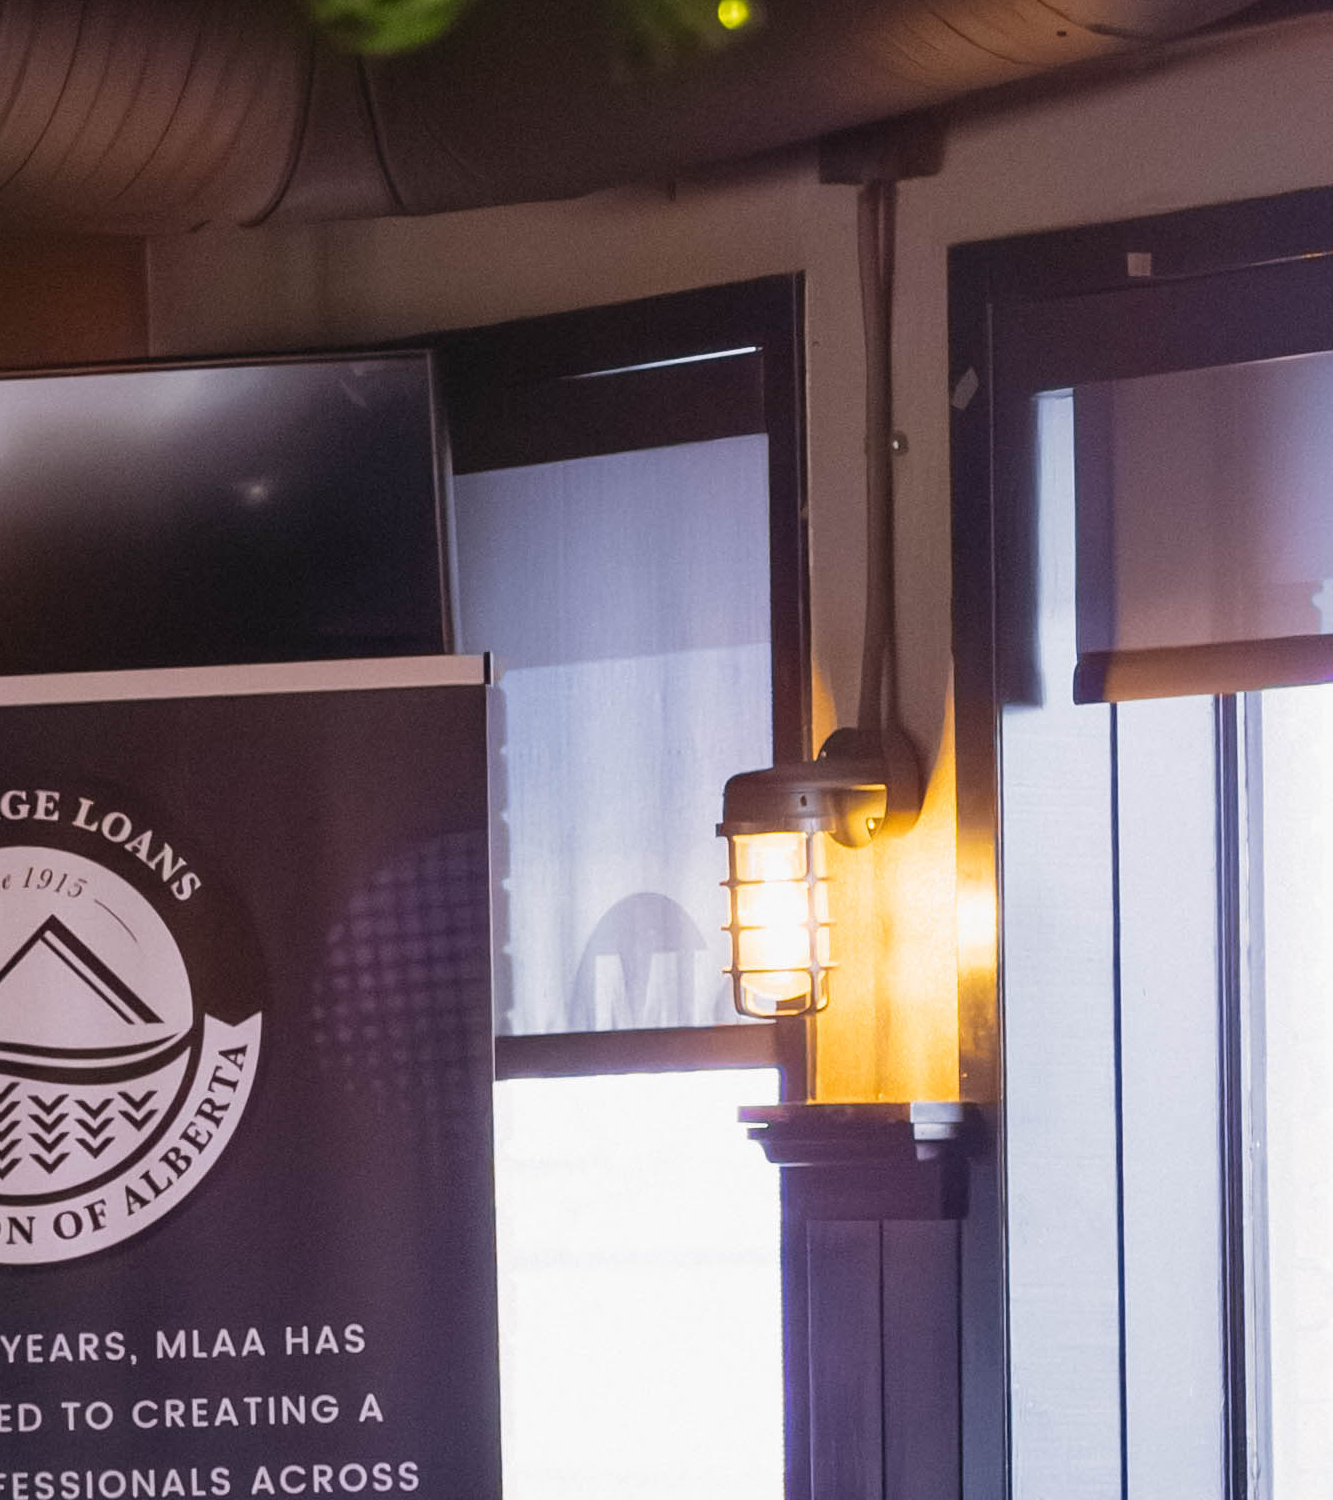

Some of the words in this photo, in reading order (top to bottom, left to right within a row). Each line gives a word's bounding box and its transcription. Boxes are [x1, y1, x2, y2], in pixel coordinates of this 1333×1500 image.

[72, 797, 202, 902] LOANS
[21, 866, 88, 900] 1915
[53, 1199, 110, 1241] OF
[125, 1043, 249, 1216] ALBERTA
[0, 1331, 137, 1365] YEARS,
[156, 1327, 266, 1359] MLAA
[285, 1323, 366, 1356] HAS
[60, 1401, 114, 1431] TO
[132, 1394, 339, 1429] CREATING
[358, 1393, 384, 1423] A
[251, 1461, 419, 1495] ACROSS
